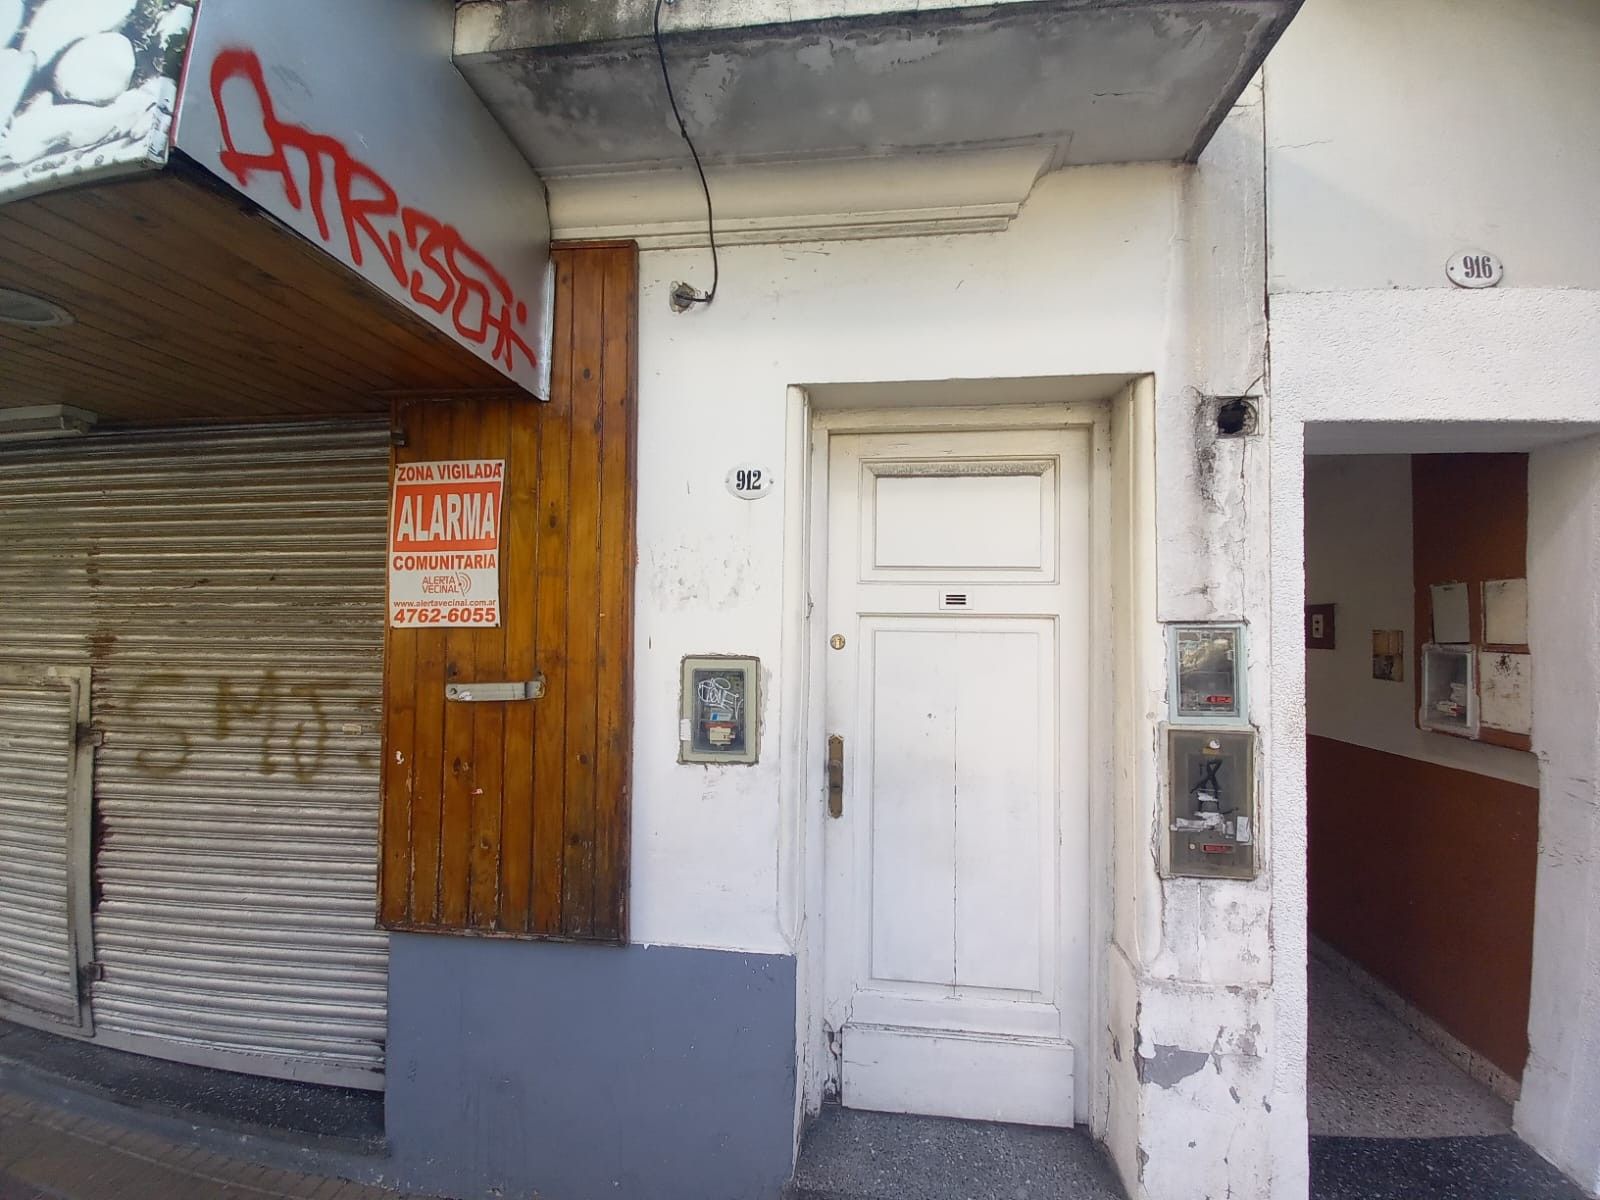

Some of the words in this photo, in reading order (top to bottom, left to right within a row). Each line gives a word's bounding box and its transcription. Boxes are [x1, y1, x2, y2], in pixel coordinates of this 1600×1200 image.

[1463, 255, 1493, 279] 916
[397, 467, 434, 482] ZONA
[437, 463, 502, 481] VIGILADA
[736, 469, 762, 491] 912
[396, 493, 496, 542] ALARMA
[393, 554, 496, 571] COMUNITARIA
[422, 576, 456, 585] ALERTA
[422, 585, 459, 594] VECINAL
[393, 599, 496, 607] www.alertavecinal.com.ar
[393, 608, 496, 623] 4762-6055
